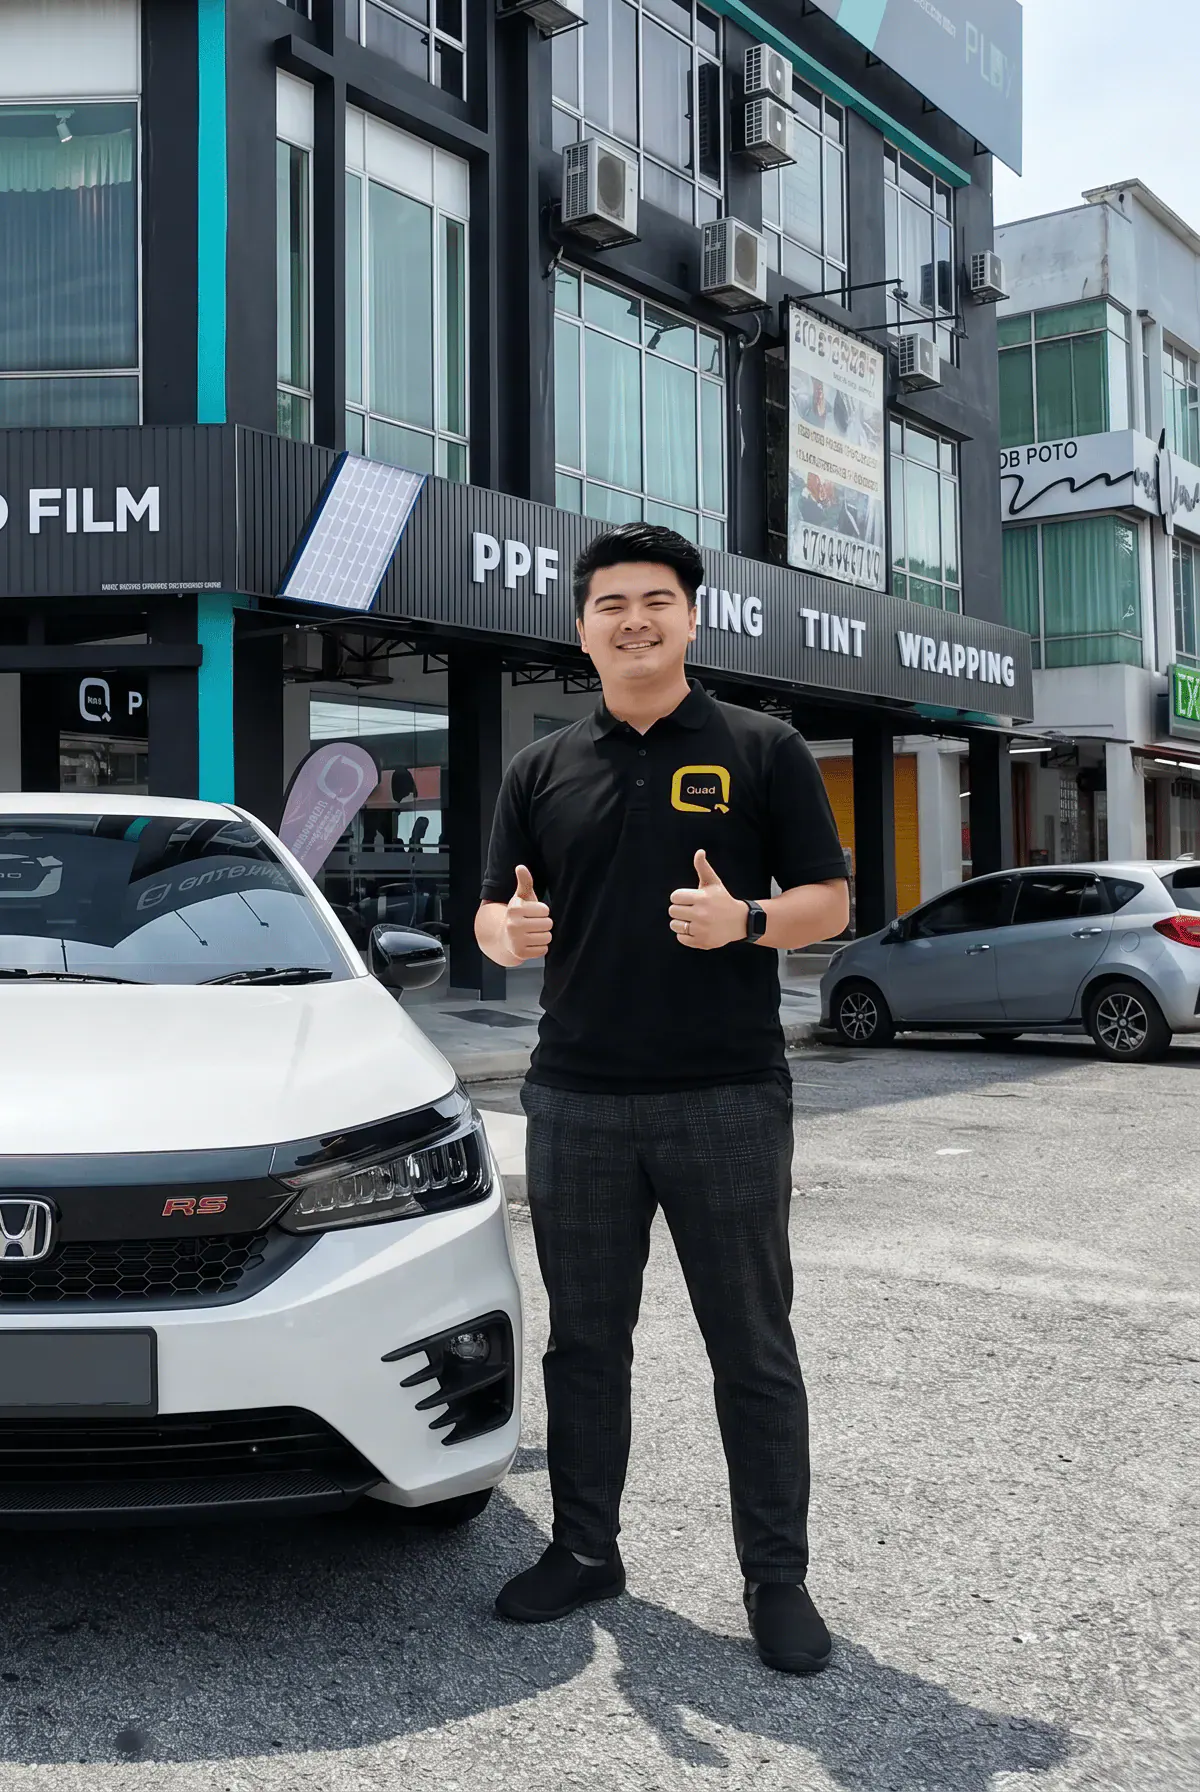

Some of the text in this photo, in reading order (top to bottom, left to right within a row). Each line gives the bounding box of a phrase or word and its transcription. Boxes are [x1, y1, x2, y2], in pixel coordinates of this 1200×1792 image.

[1026, 441, 1078, 465] POTO
[29, 486, 160, 534] FILM
[473, 531, 1015, 687] PPF TING TINT WRAPPING
[686, 785, 716, 795] Quad
[161, 1194, 229, 1217] RS
